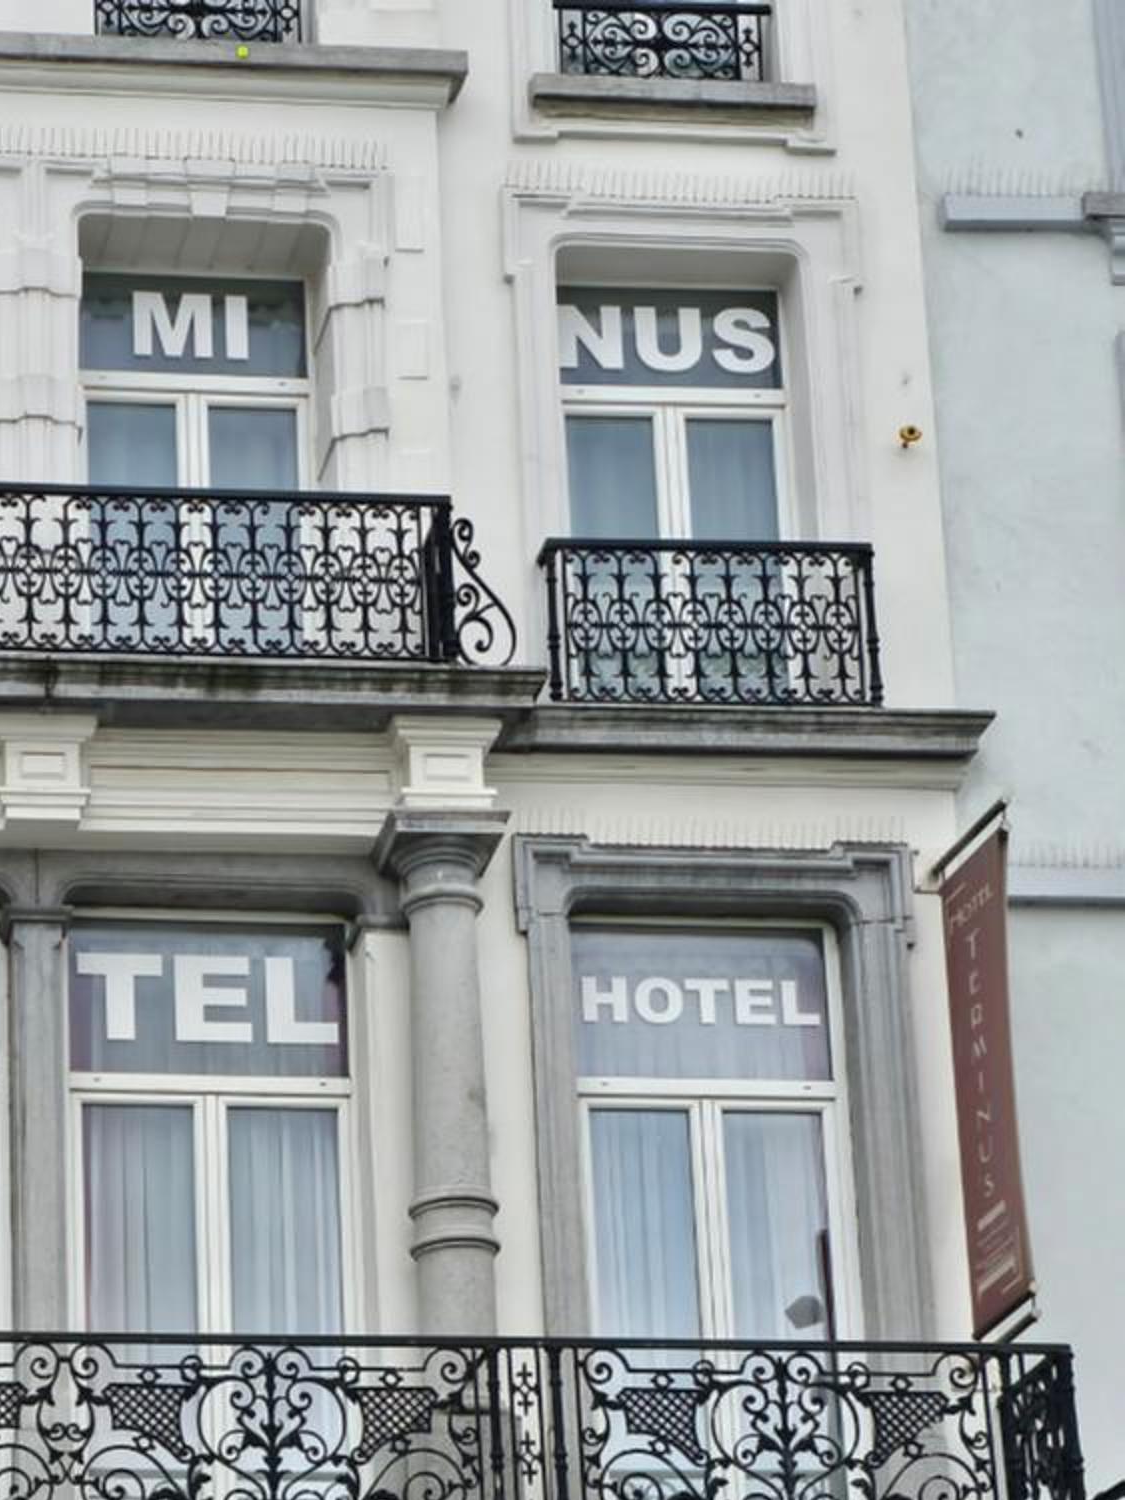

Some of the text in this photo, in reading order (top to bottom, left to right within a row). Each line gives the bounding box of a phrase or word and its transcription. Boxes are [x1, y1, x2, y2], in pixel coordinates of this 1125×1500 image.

[131, 290, 249, 361] MI
[557, 304, 776, 373] NUS
[77, 953, 340, 1045] TEL
[580, 975, 823, 1027] HOTEL
